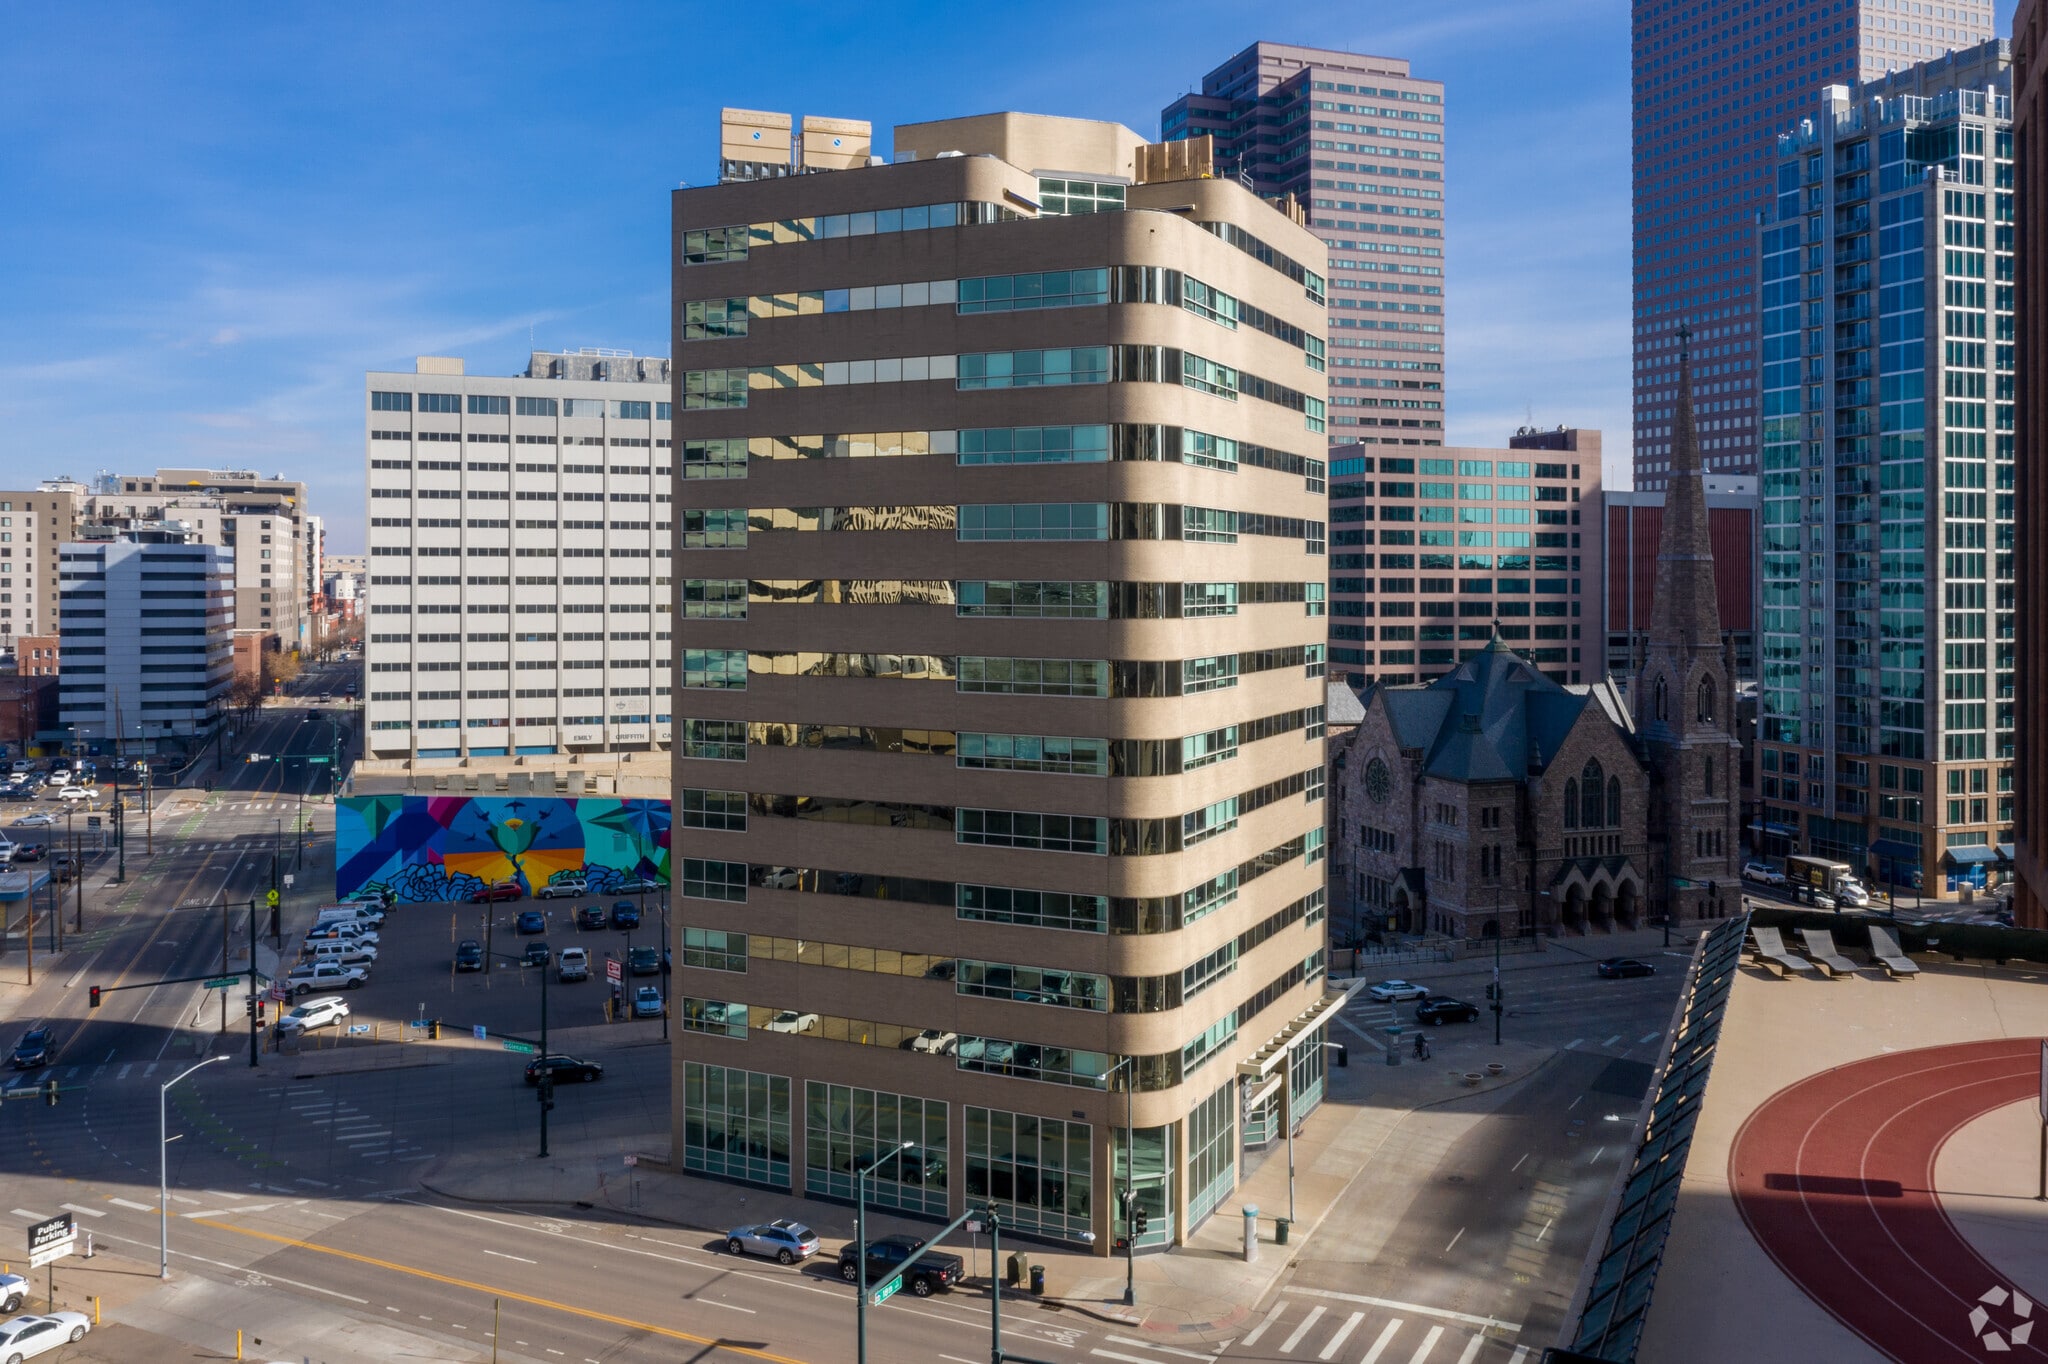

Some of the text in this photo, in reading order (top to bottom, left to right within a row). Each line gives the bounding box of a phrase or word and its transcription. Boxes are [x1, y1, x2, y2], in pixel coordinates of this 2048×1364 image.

[182, 897, 209, 906] ONLY
[38, 1220, 65, 1236] Public
[34, 1227, 68, 1246] Parking
